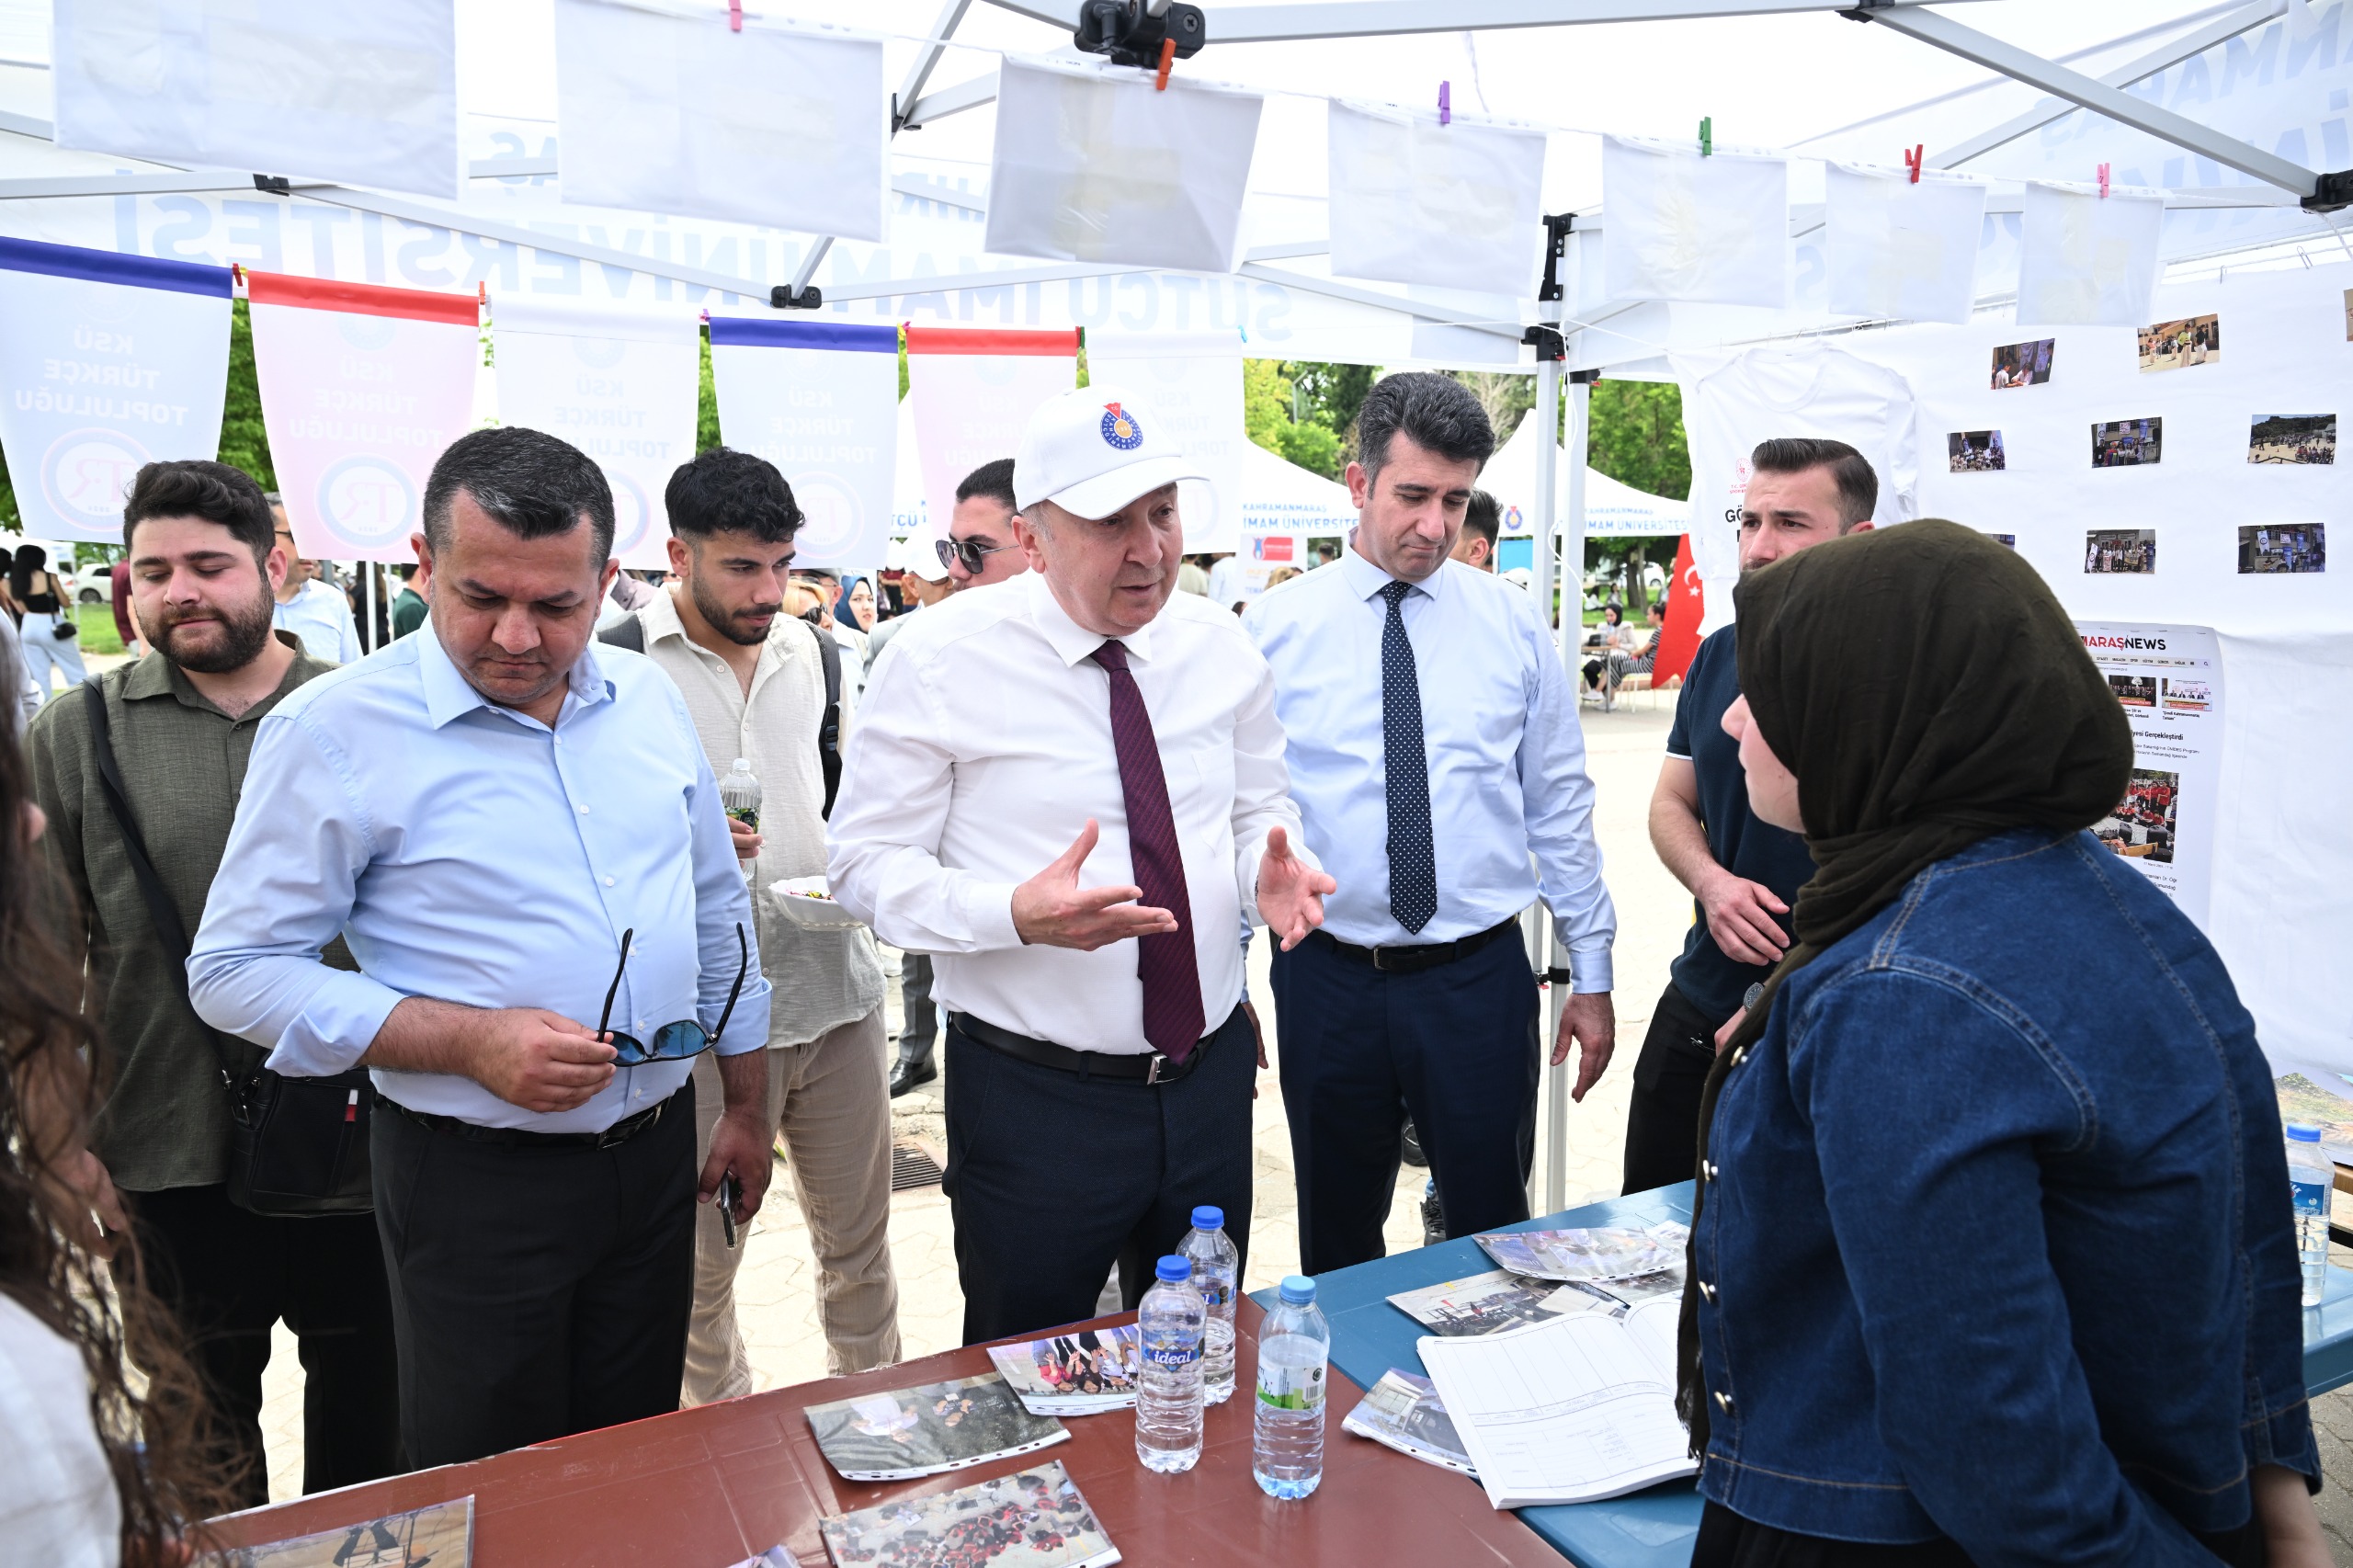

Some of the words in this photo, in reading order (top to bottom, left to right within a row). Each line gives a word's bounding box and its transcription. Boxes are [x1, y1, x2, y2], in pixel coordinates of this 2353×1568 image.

[1243, 503, 1327, 513] KAHRAMANMARAŞ
[1243, 514, 1279, 529] İMAM
[1282, 514, 1359, 529] ÜNİVERSİTE
[2144, 731, 2184, 741] Gerçekleştirdi
[1154, 1350, 1191, 1365] ideal
